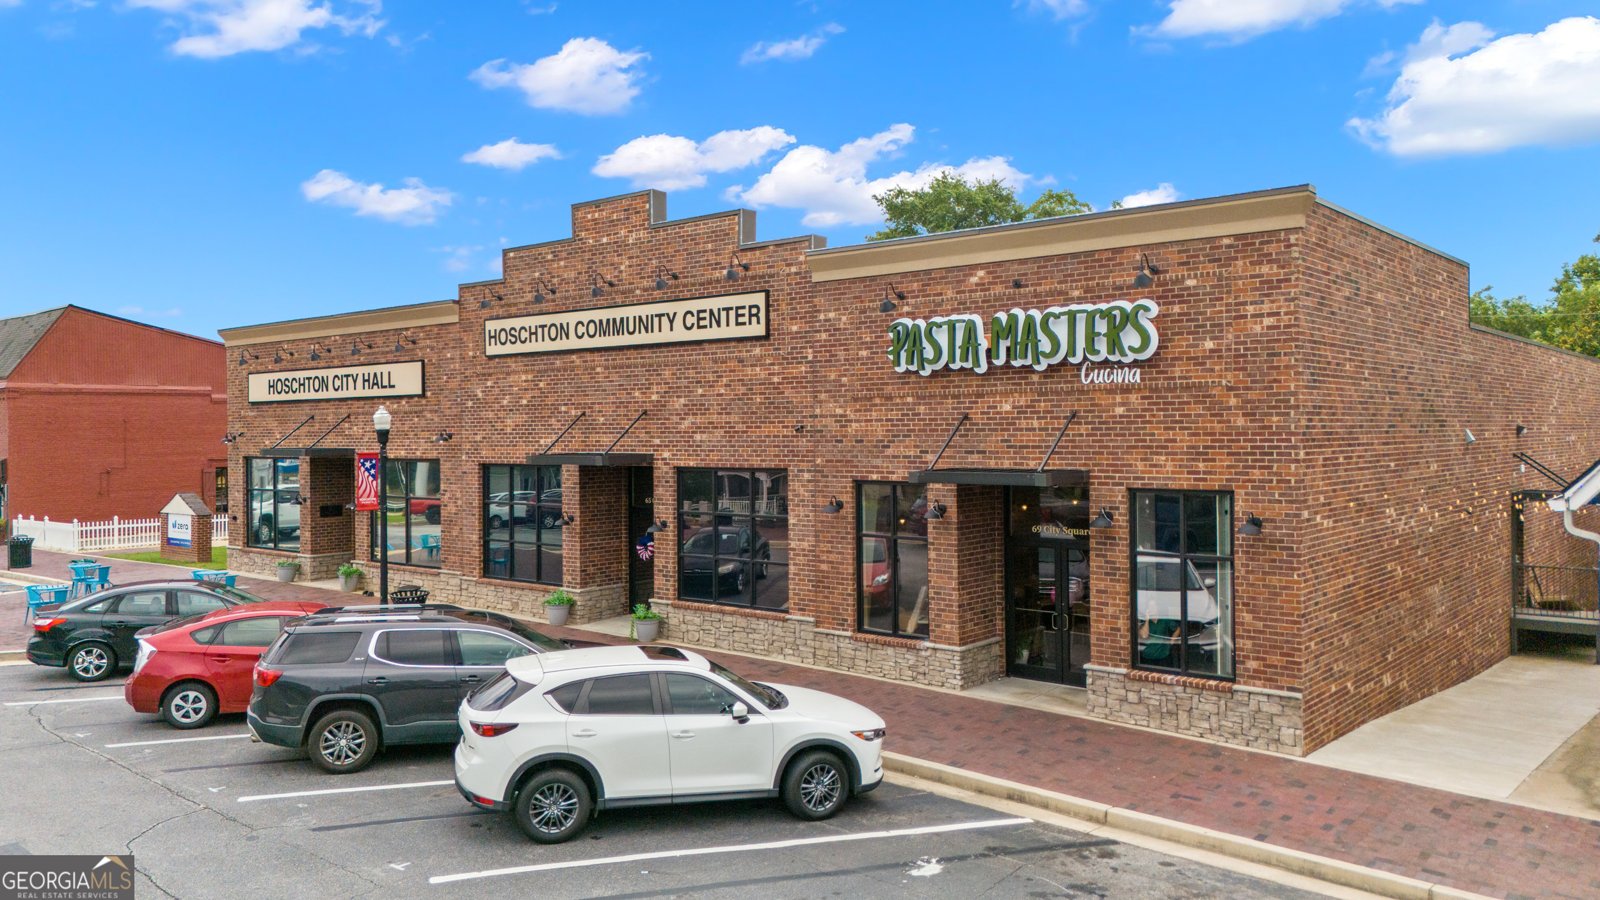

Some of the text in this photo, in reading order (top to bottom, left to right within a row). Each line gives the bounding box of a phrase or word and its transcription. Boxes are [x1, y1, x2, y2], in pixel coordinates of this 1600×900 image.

[488, 303, 761, 346] HOSCHTON COMMUNITY CENTER
[887, 300, 1157, 375] PASTA MASTERS
[268, 371, 395, 395] HOSCHTON CITY HALL
[1081, 361, 1141, 384] Cucina
[1031, 525, 1041, 533] 69
[1043, 525, 1060, 536] City
